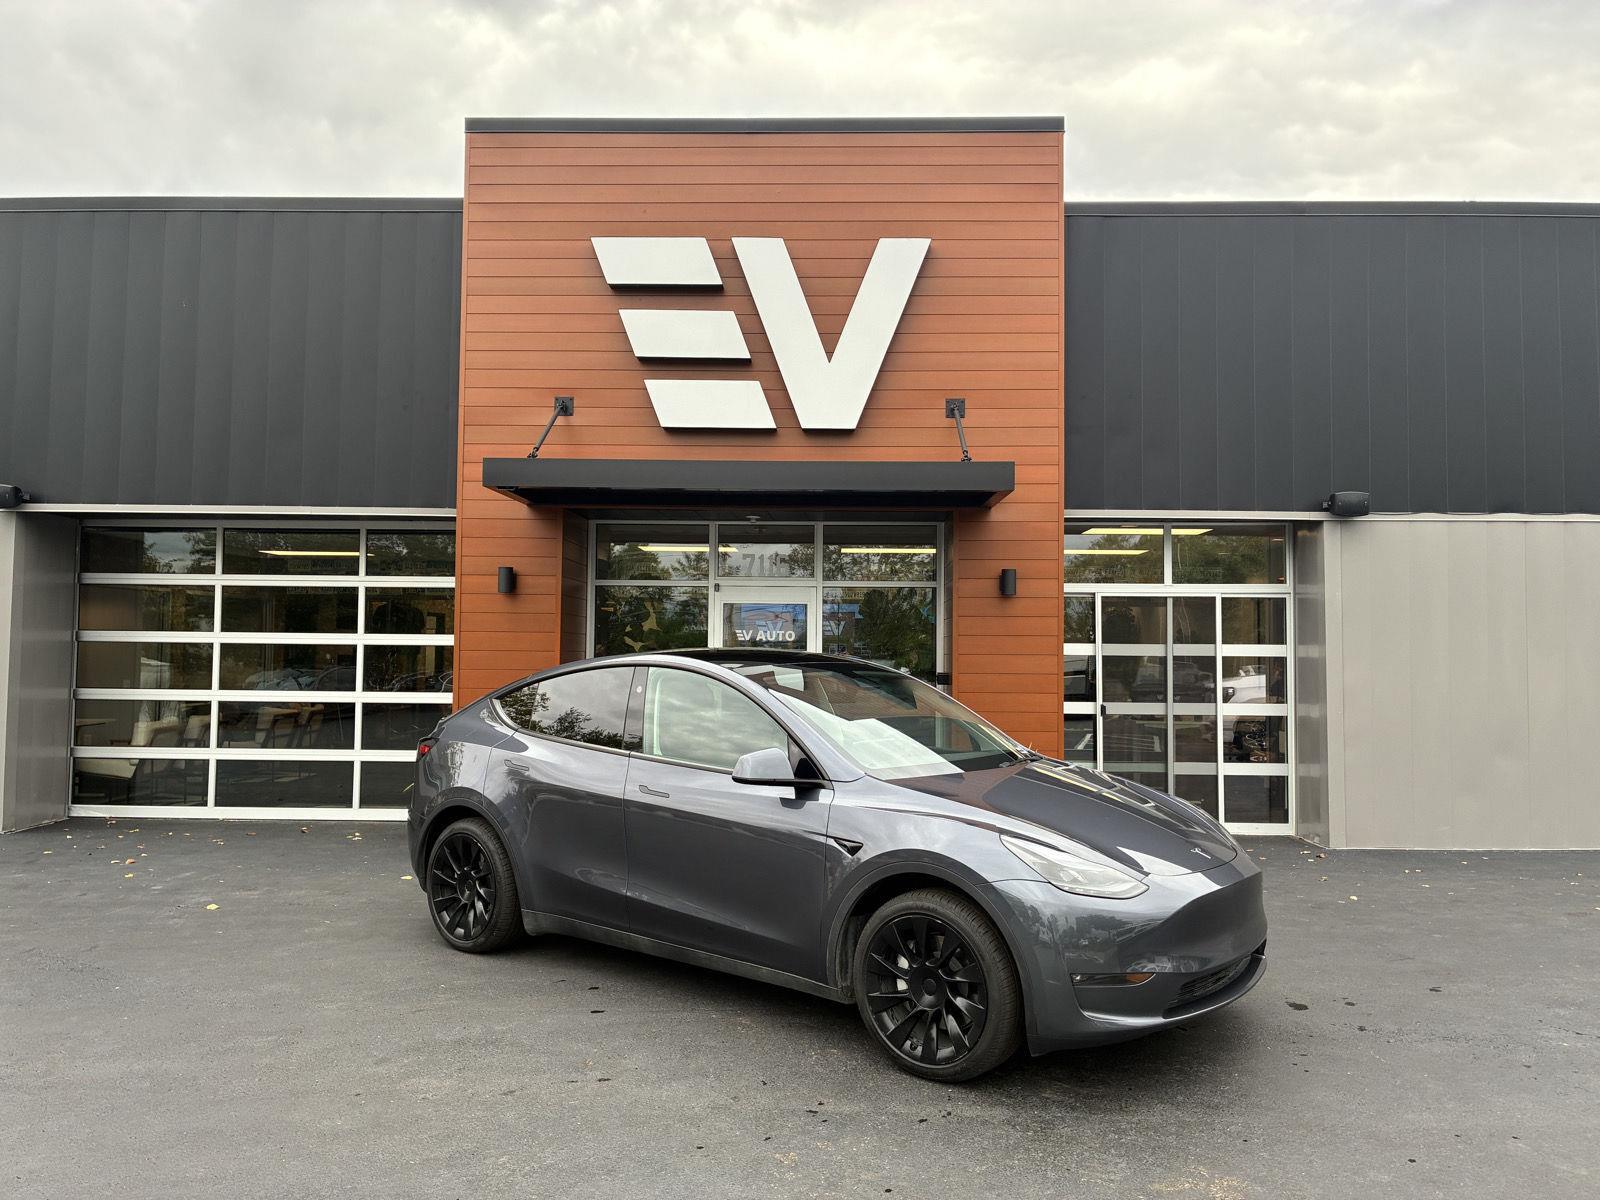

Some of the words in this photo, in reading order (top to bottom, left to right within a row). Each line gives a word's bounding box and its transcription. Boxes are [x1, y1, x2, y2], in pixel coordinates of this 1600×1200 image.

[590, 237, 932, 430] EV
[735, 629, 754, 641] EV
[756, 630, 796, 641] AUTO
